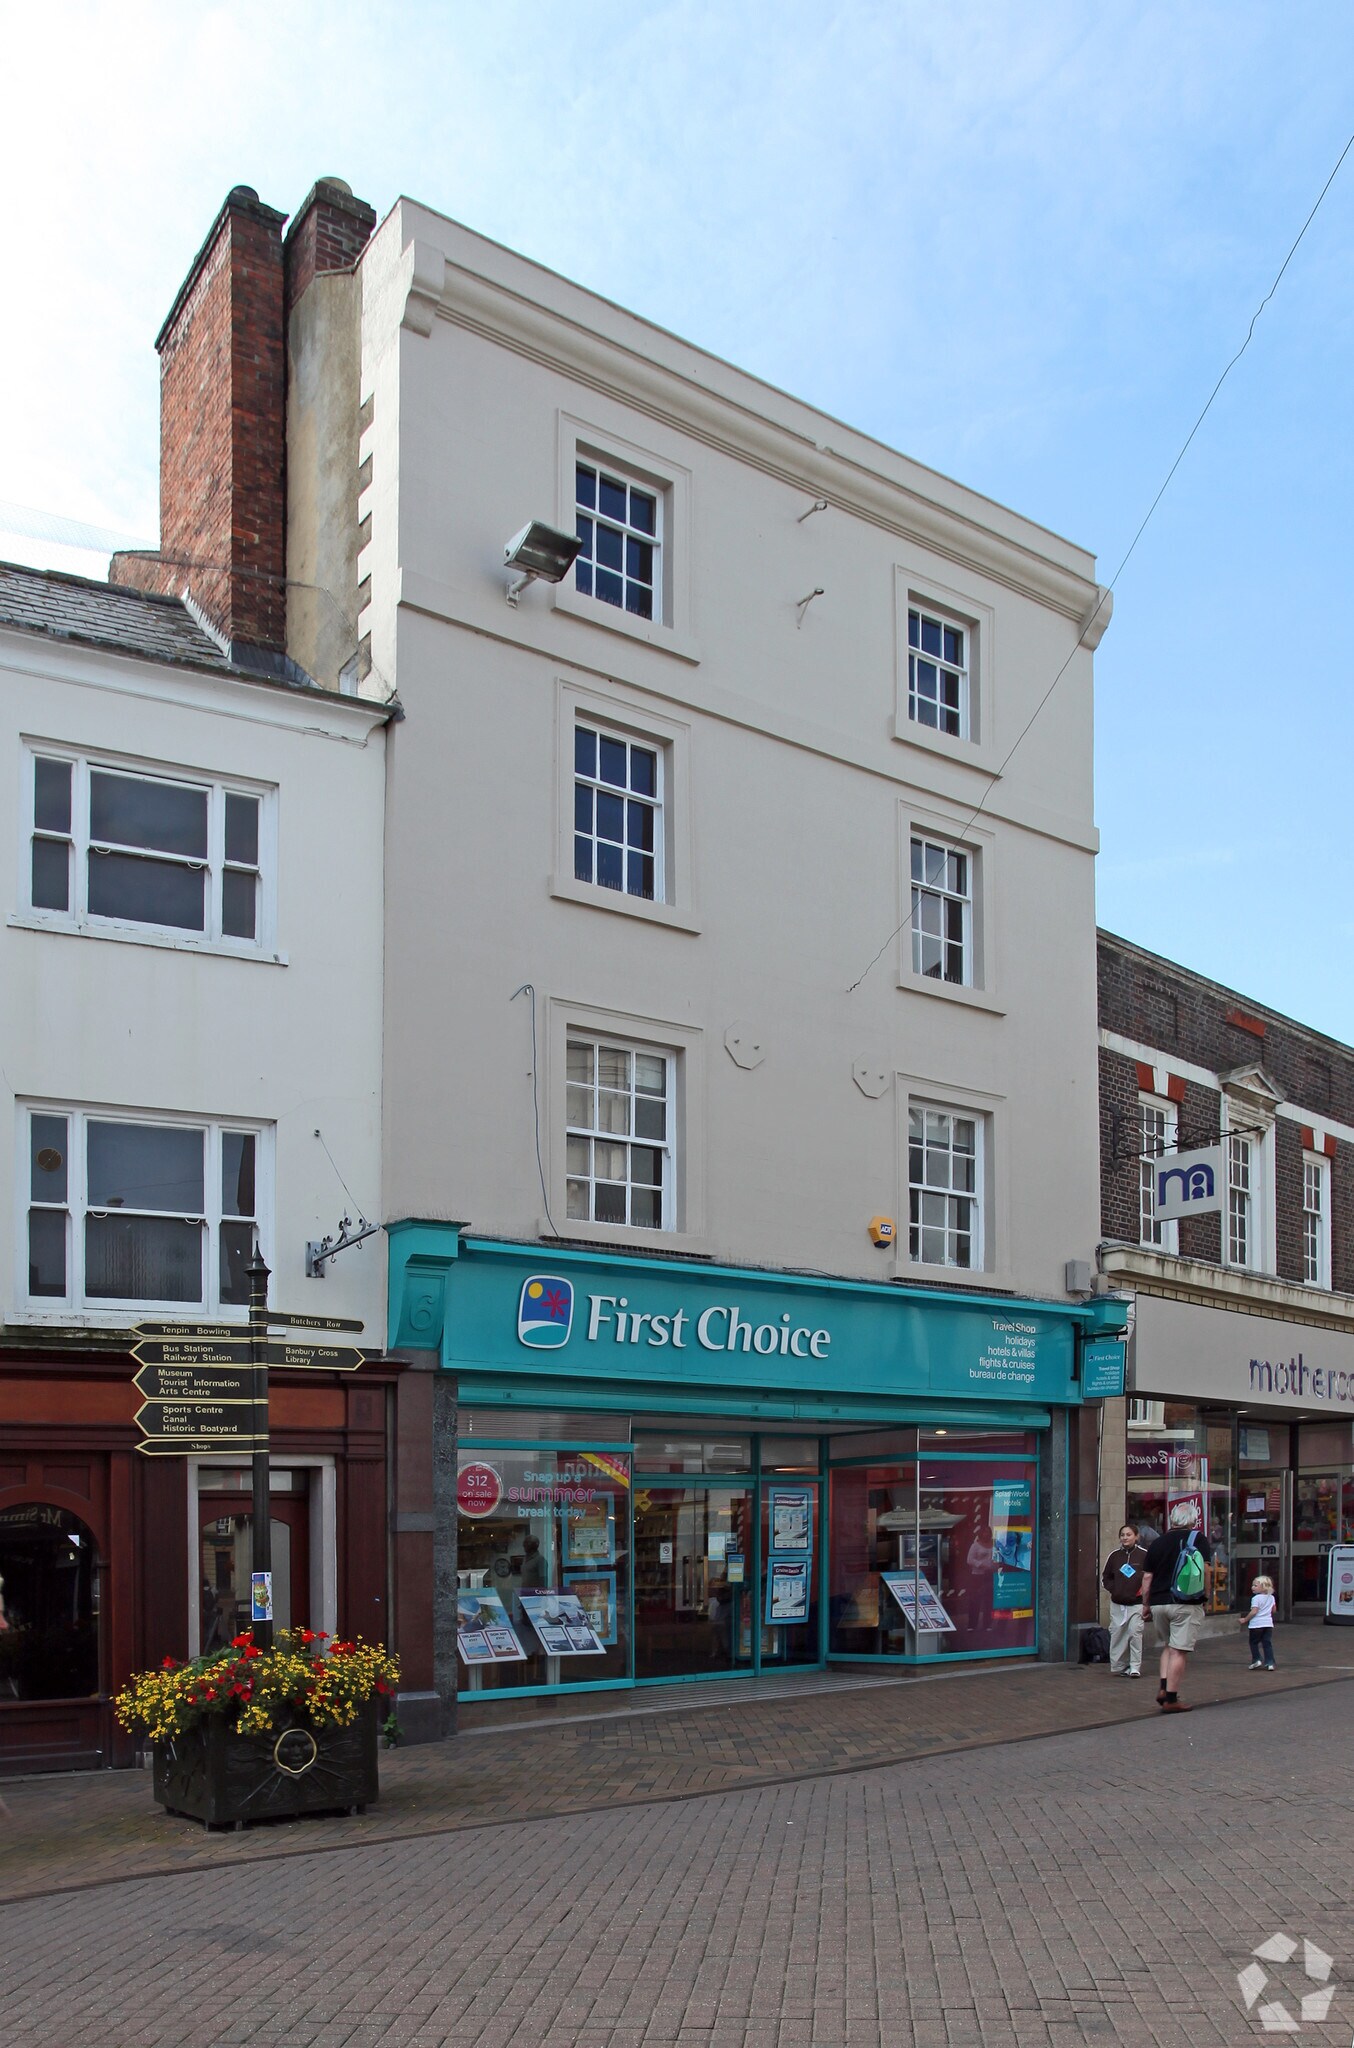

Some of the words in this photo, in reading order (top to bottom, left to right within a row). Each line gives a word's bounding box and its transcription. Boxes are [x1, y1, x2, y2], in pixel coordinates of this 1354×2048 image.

[409, 1294, 435, 1331] 6
[290, 1317, 320, 1326] Butchers
[326, 1320, 341, 1328] Row
[587, 1294, 689, 1348] First
[698, 1306, 831, 1358] Choice
[992, 1320, 1015, 1331] Travel
[1015, 1322, 1036, 1334] Shop
[161, 1326, 190, 1335] Tenpin
[197, 1327, 231, 1336] Bowling
[1005, 1335, 1036, 1348] holidays
[162, 1345, 179, 1353] Bus
[183, 1345, 213, 1353] Station
[285, 1347, 316, 1357] Banbury
[318, 1349, 338, 1357] Cross
[987, 1346, 1010, 1357] hotels
[1011, 1347, 1017, 1357] &
[1018, 1348, 1036, 1358] villas
[163, 1354, 197, 1362] Railway
[285, 1356, 311, 1365] Library
[979, 1356, 1001, 1369] flights
[1002, 1358, 1008, 1368] &
[1009, 1360, 1035, 1370] cruises
[158, 1369, 193, 1377] Museum
[969, 1368, 996, 1379] bureau
[997, 1371, 1006, 1380] de
[1007, 1371, 1035, 1384] change
[160, 1379, 187, 1387] Tourist
[193, 1379, 240, 1387] Information
[159, 1387, 178, 1395] Arts
[182, 1388, 211, 1396] Centre
[163, 1406, 191, 1414] Sports
[163, 1415, 187, 1423] Canal
[200, 1425, 238, 1433] Boatyard
[523, 1470, 552, 1484] Snap
[554, 1473, 571, 1484] up
[574, 1473, 582, 1483] a
[475, 1490, 492, 1498] sale
[508, 1486, 596, 1503] summer
[1003, 1499, 1022, 1507] Hotels
[517, 1506, 550, 1518] break
[553, 1506, 586, 1519] today
